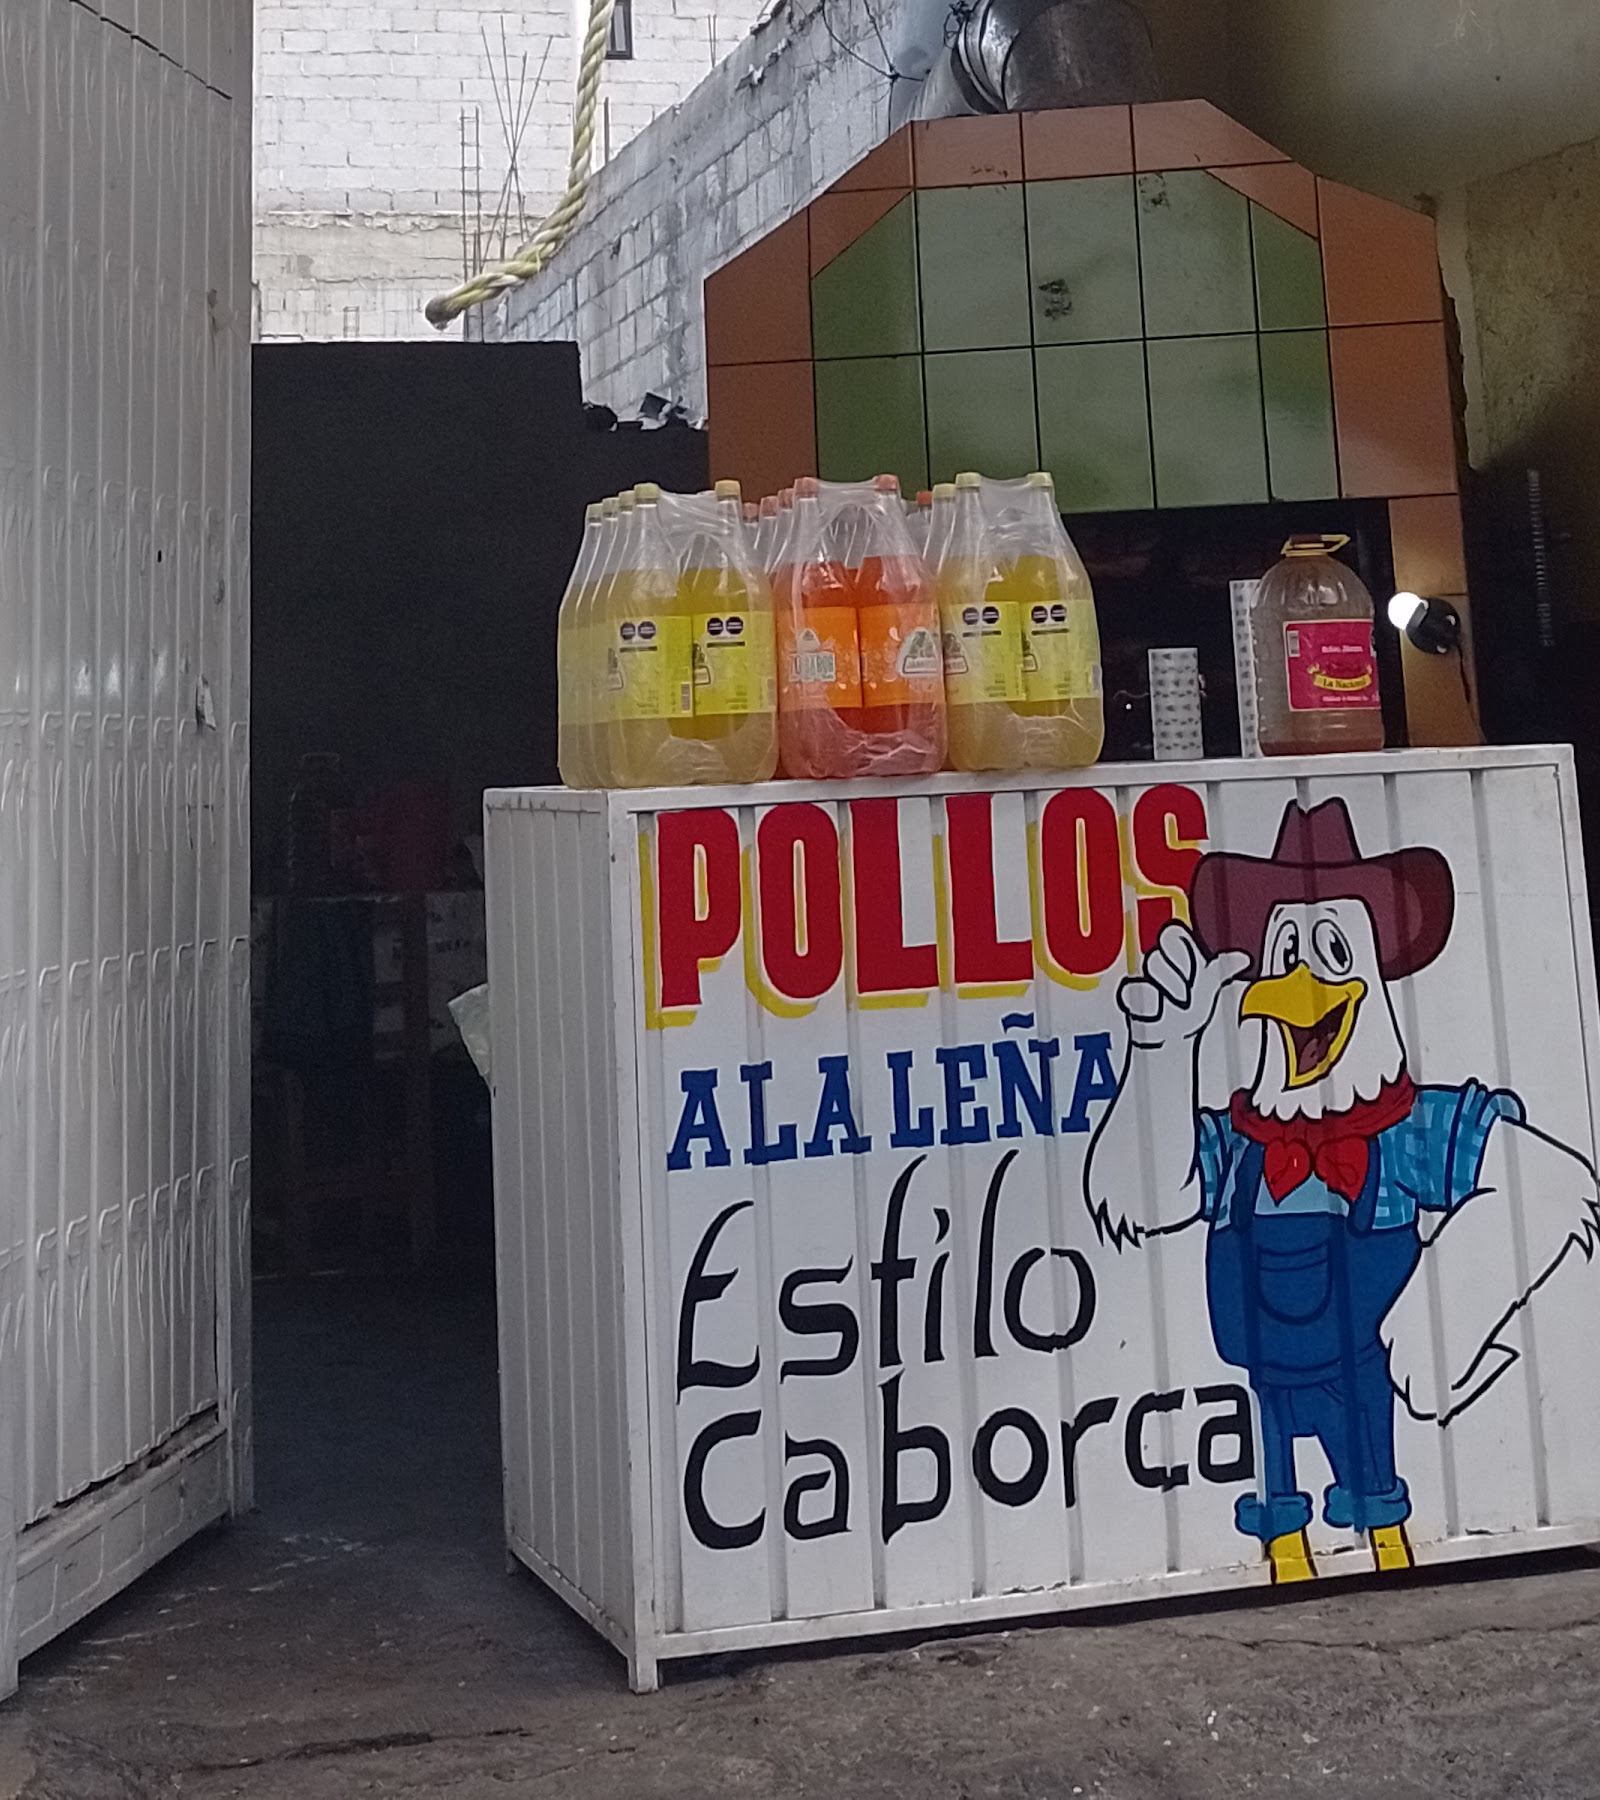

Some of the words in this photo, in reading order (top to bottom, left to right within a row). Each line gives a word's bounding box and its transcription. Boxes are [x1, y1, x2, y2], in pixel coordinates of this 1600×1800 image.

[640, 784, 1209, 1029] POLLOS
[886, 1012, 1120, 1151] LEÑA
[676, 1148, 1097, 1406] Estilo
[681, 1368, 1256, 1550] Caborca
